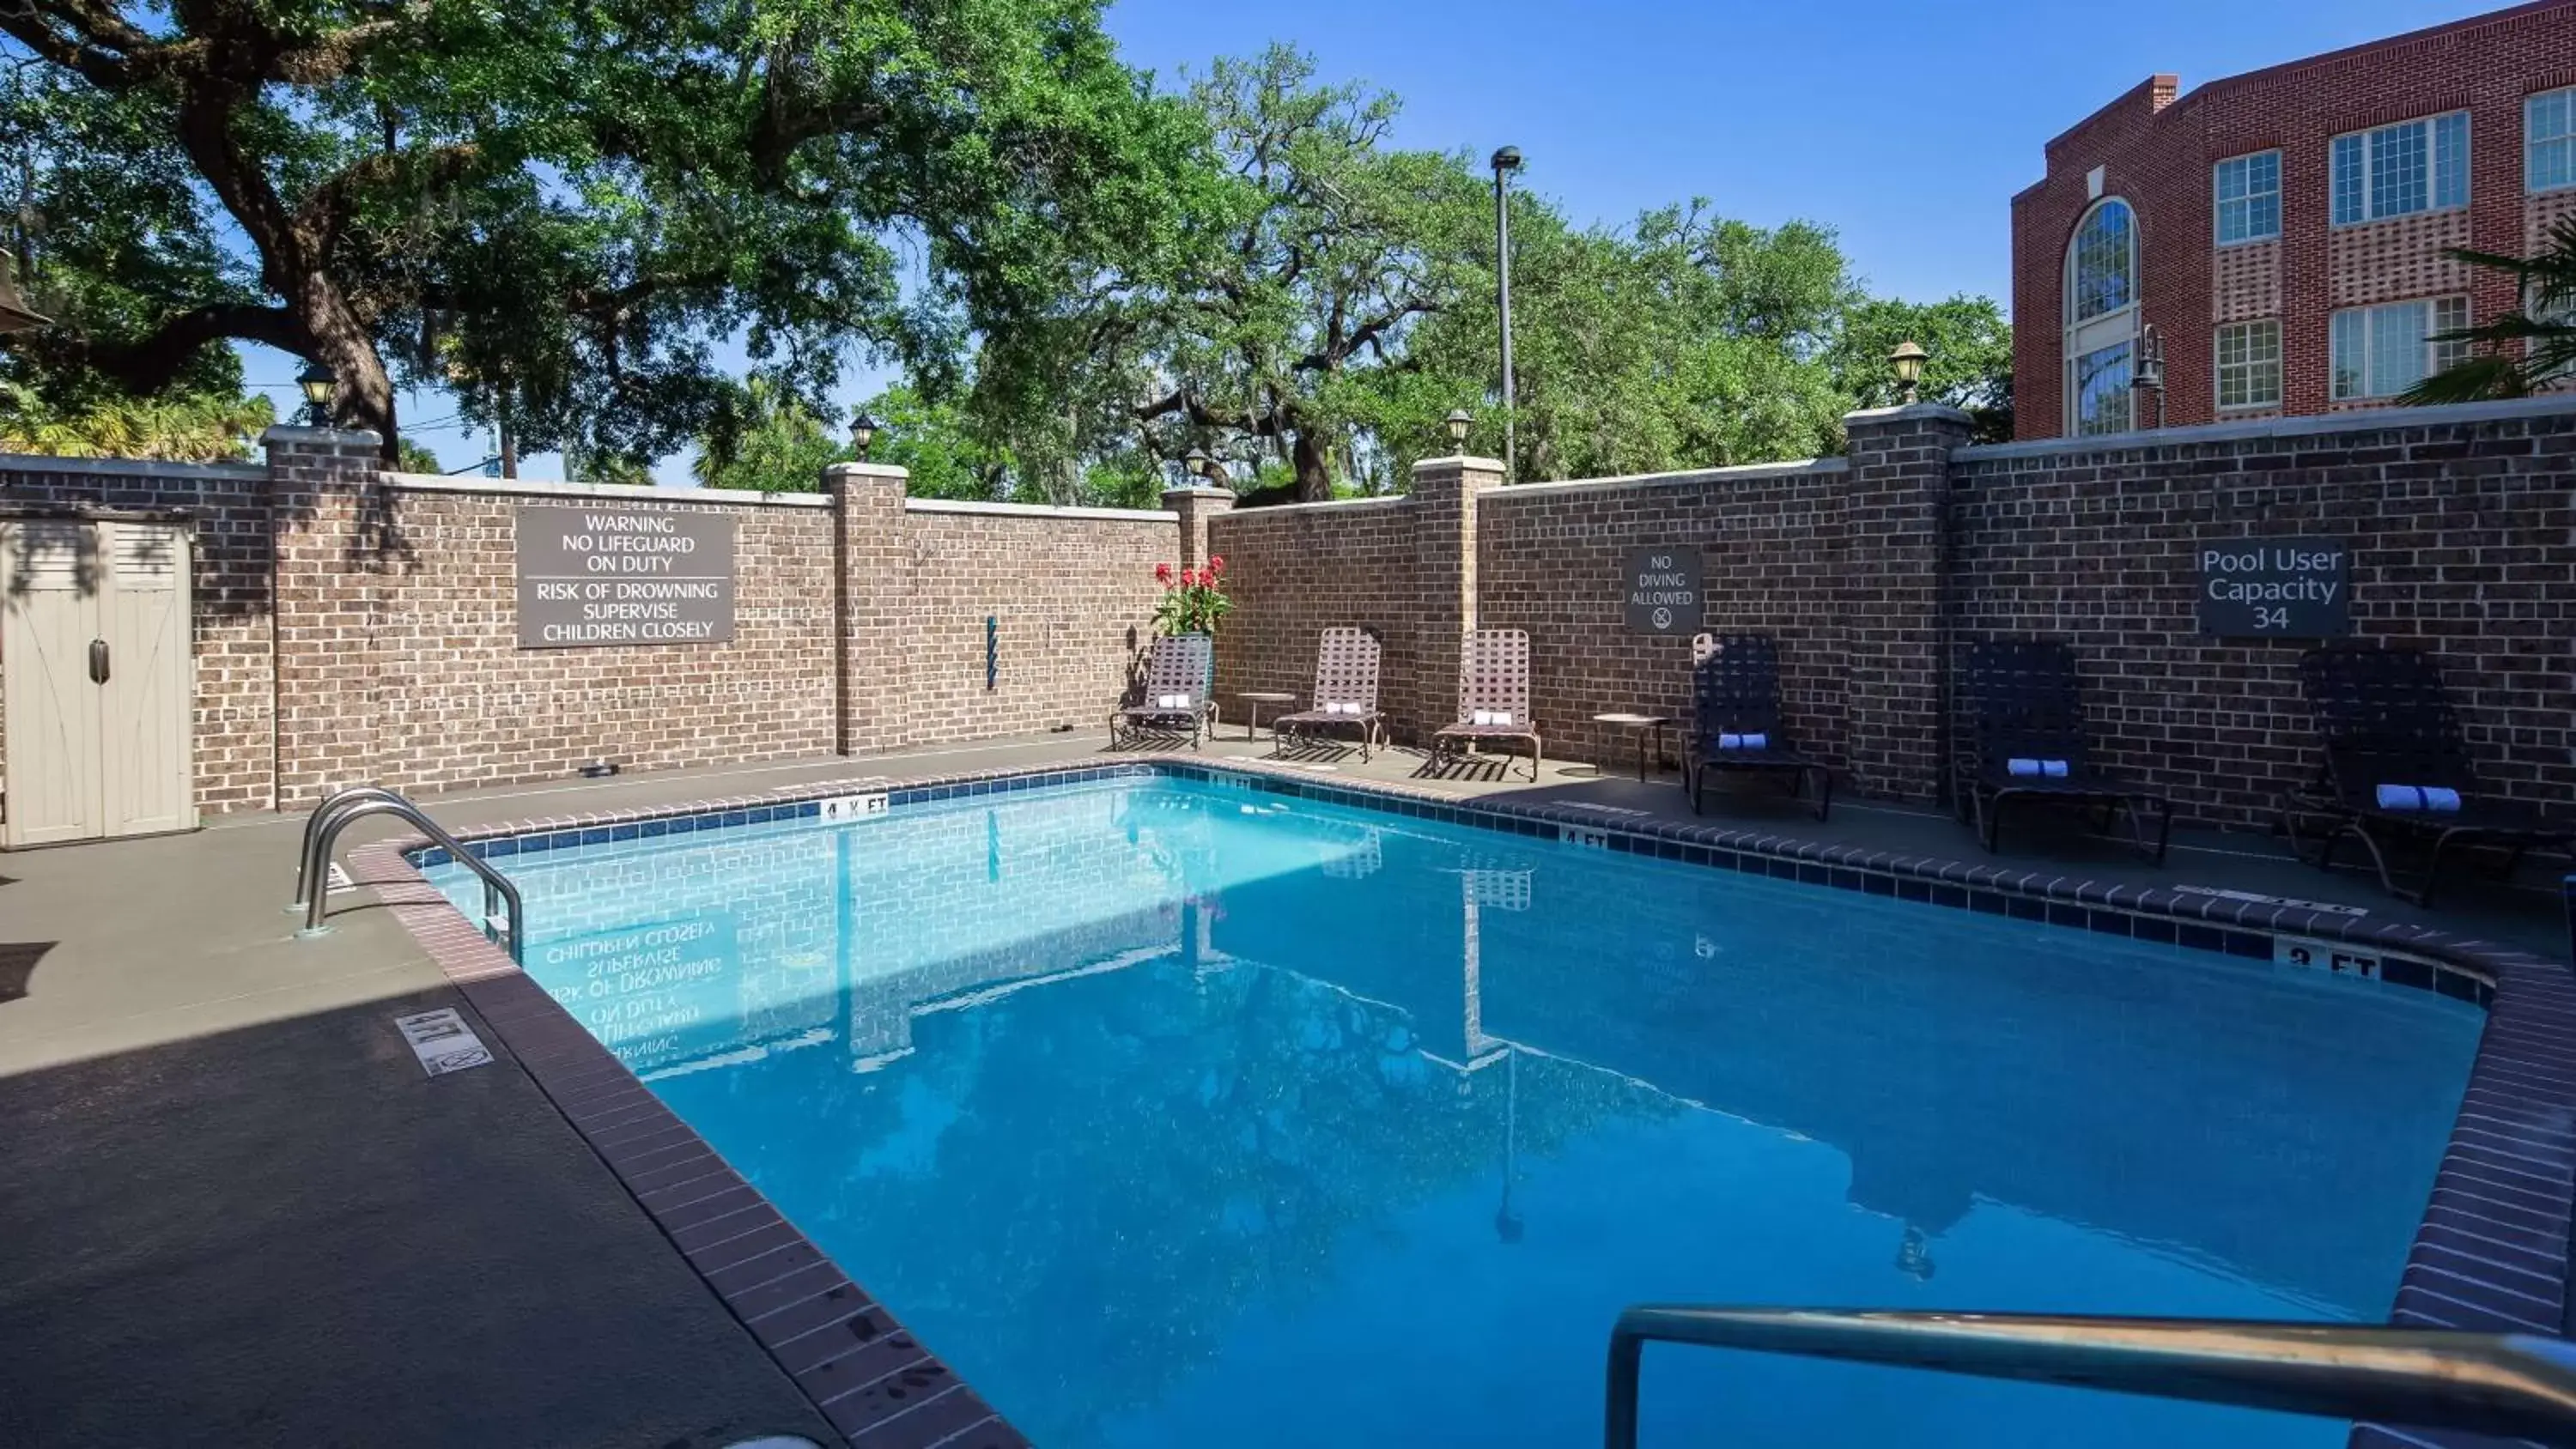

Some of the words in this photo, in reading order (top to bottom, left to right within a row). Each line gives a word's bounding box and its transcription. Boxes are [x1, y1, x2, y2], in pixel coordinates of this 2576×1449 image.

[585, 514, 675, 533] WARNING
[562, 535, 592, 551] NO
[598, 536, 695, 553] LIFEGUARD
[587, 556, 616, 572] ON
[623, 556, 672, 573] DUTY
[1650, 555, 1672, 569] NO
[2203, 548, 2264, 573] Pool
[2276, 549, 2343, 571] User
[1638, 573, 1686, 588] DIVING
[537, 583, 580, 600] RISK
[586, 583, 611, 599] OF
[617, 583, 719, 599] DROWNING
[1631, 591, 1693, 605] ALLOWED
[2208, 576, 2337, 605] Capacity
[583, 603, 677, 621] SUPERVISE
[2252, 606, 2290, 629] 34
[544, 622, 636, 641] CHILDREN
[641, 621, 714, 639] CLOSELY
[2330, 953, 2377, 976] FT
